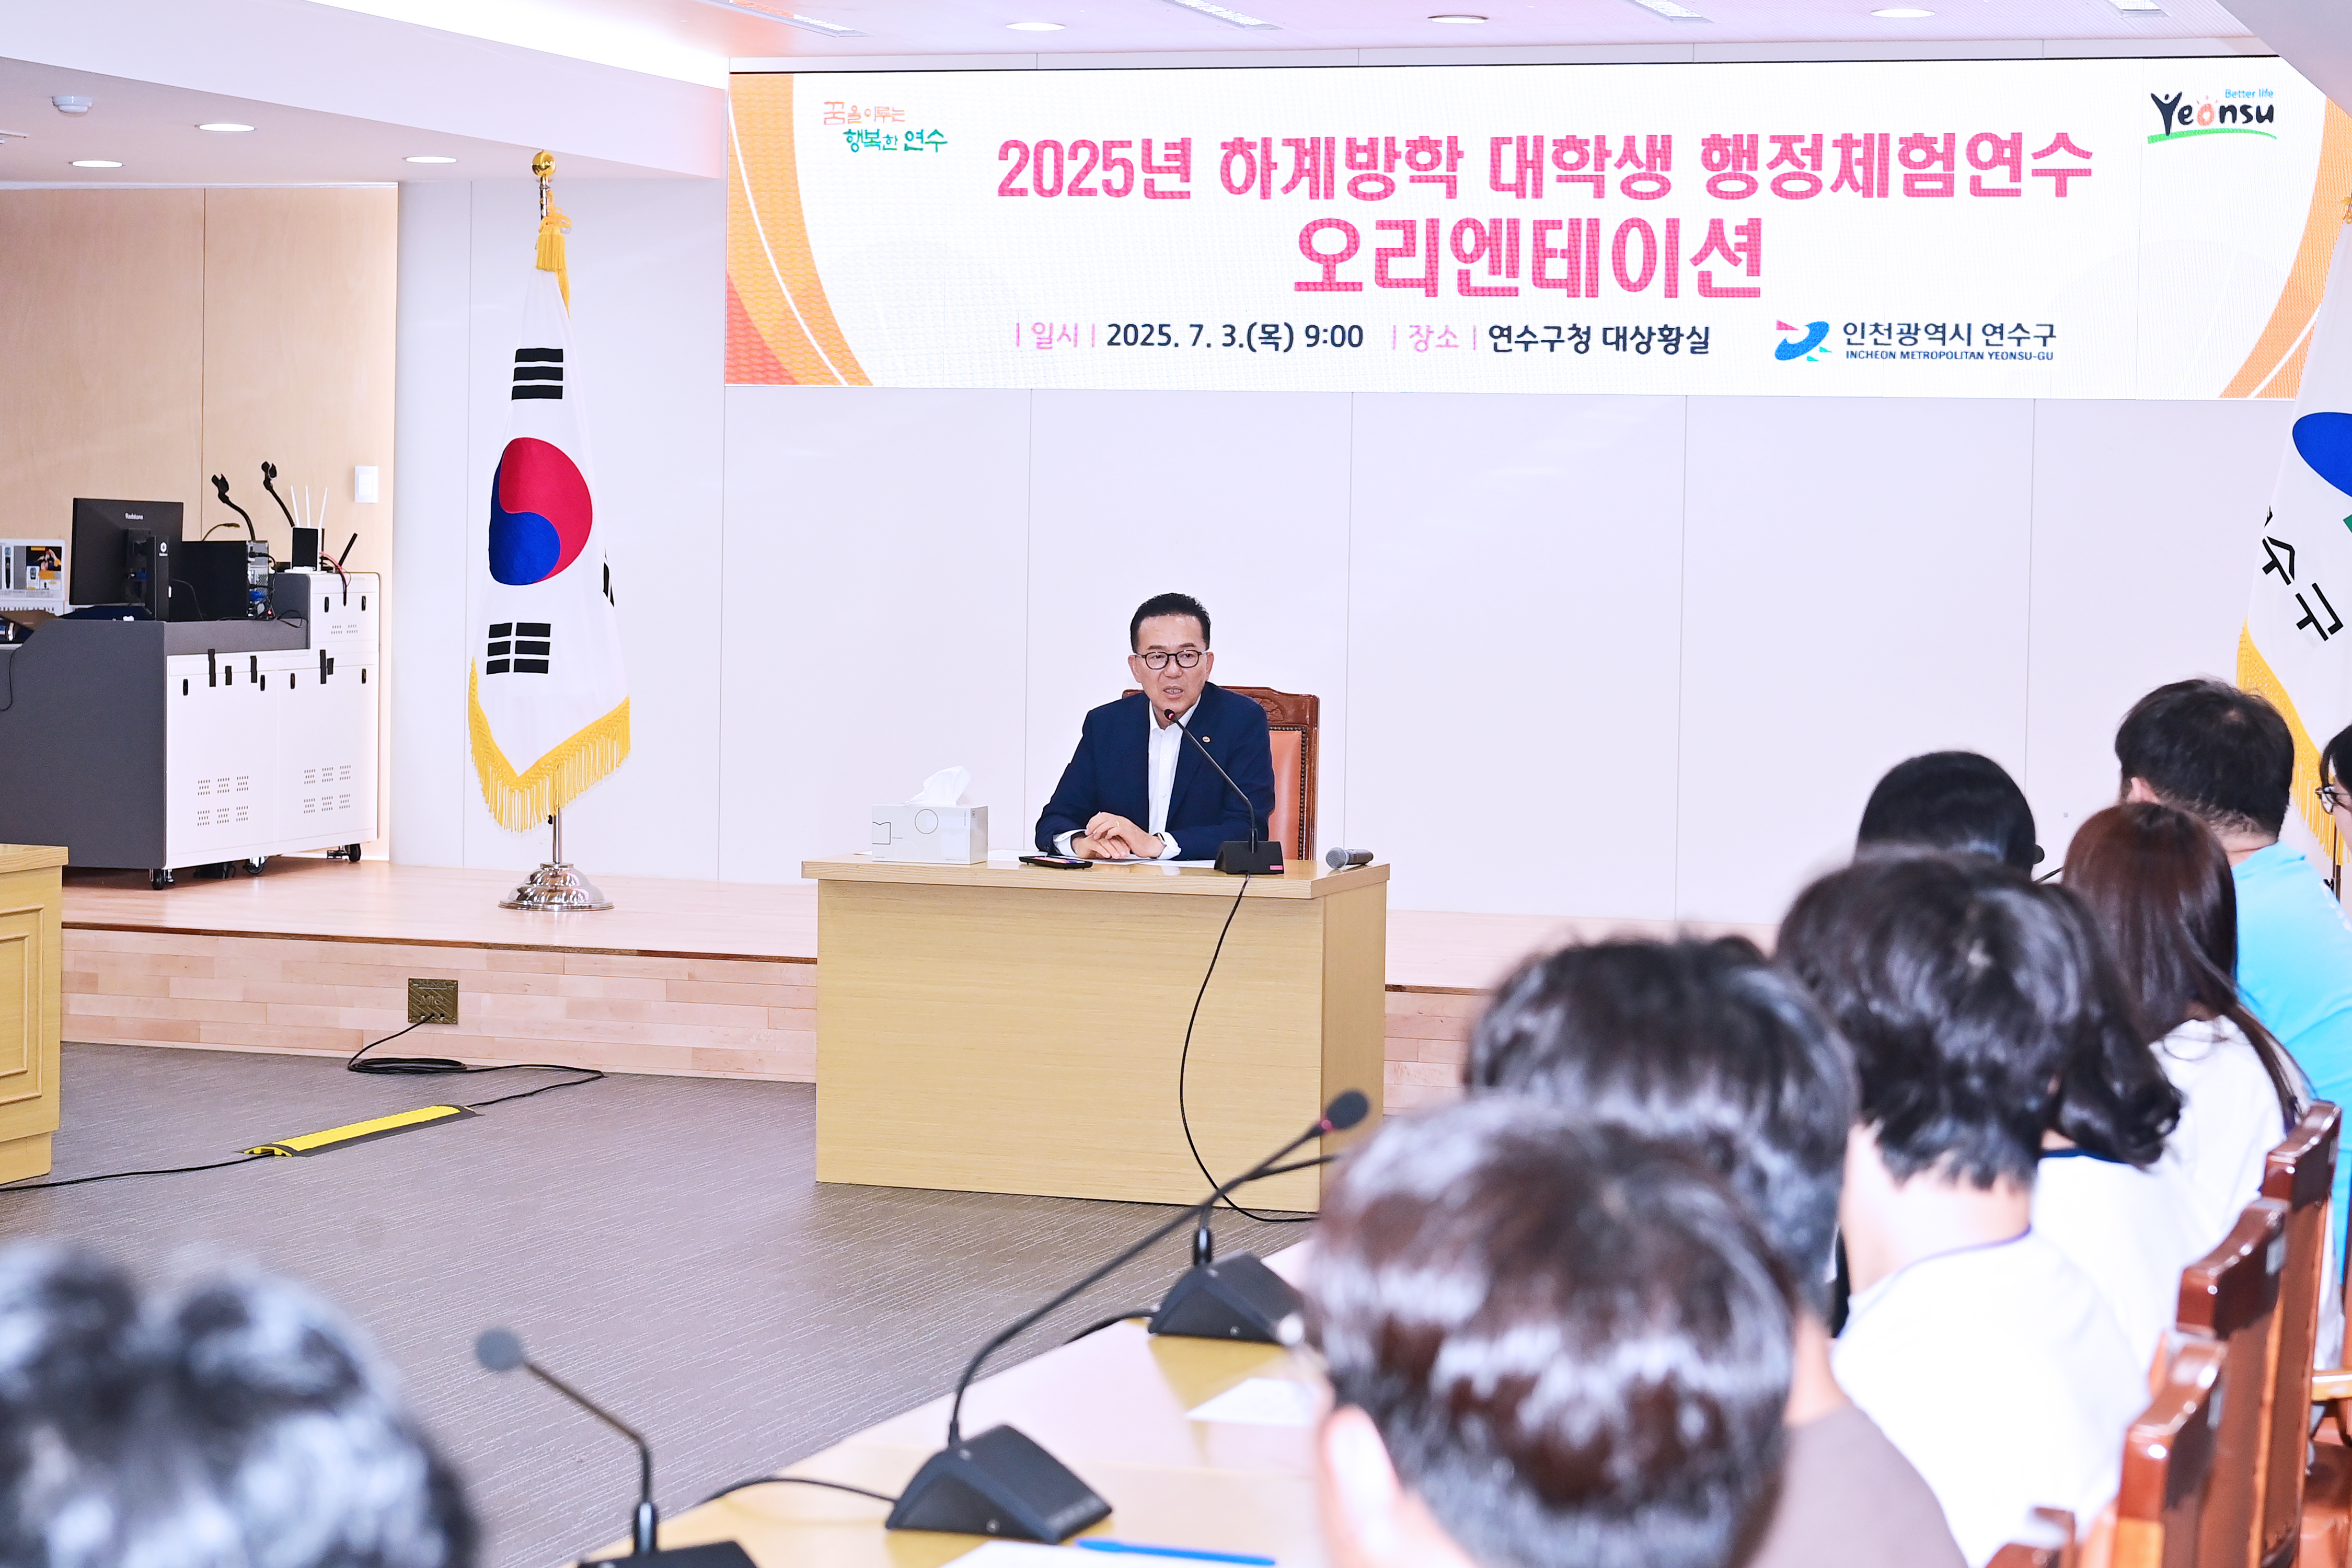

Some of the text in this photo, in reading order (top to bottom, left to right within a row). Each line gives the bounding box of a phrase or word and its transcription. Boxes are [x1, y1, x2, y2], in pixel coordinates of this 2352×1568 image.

[2226, 88, 2274, 98] Better life
[2150, 91, 2274, 136] Yeonsu
[843, 129, 948, 153] 행복한 연수
[998, 132, 2093, 201] 2025년 하계방학 대학생 행정체험연수
[1295, 217, 1761, 298] 오리엔테이션
[1032, 322, 1363, 353] 일시 2025. 7. 3.(목) 9:00
[1409, 324, 1709, 355] 장소 연수구청 대상황실
[1843, 322, 2056, 347] 인천광역시 연수구
[1847, 351, 1896, 359] INCHEON
[1988, 351, 2054, 361] YEONSU-GU
